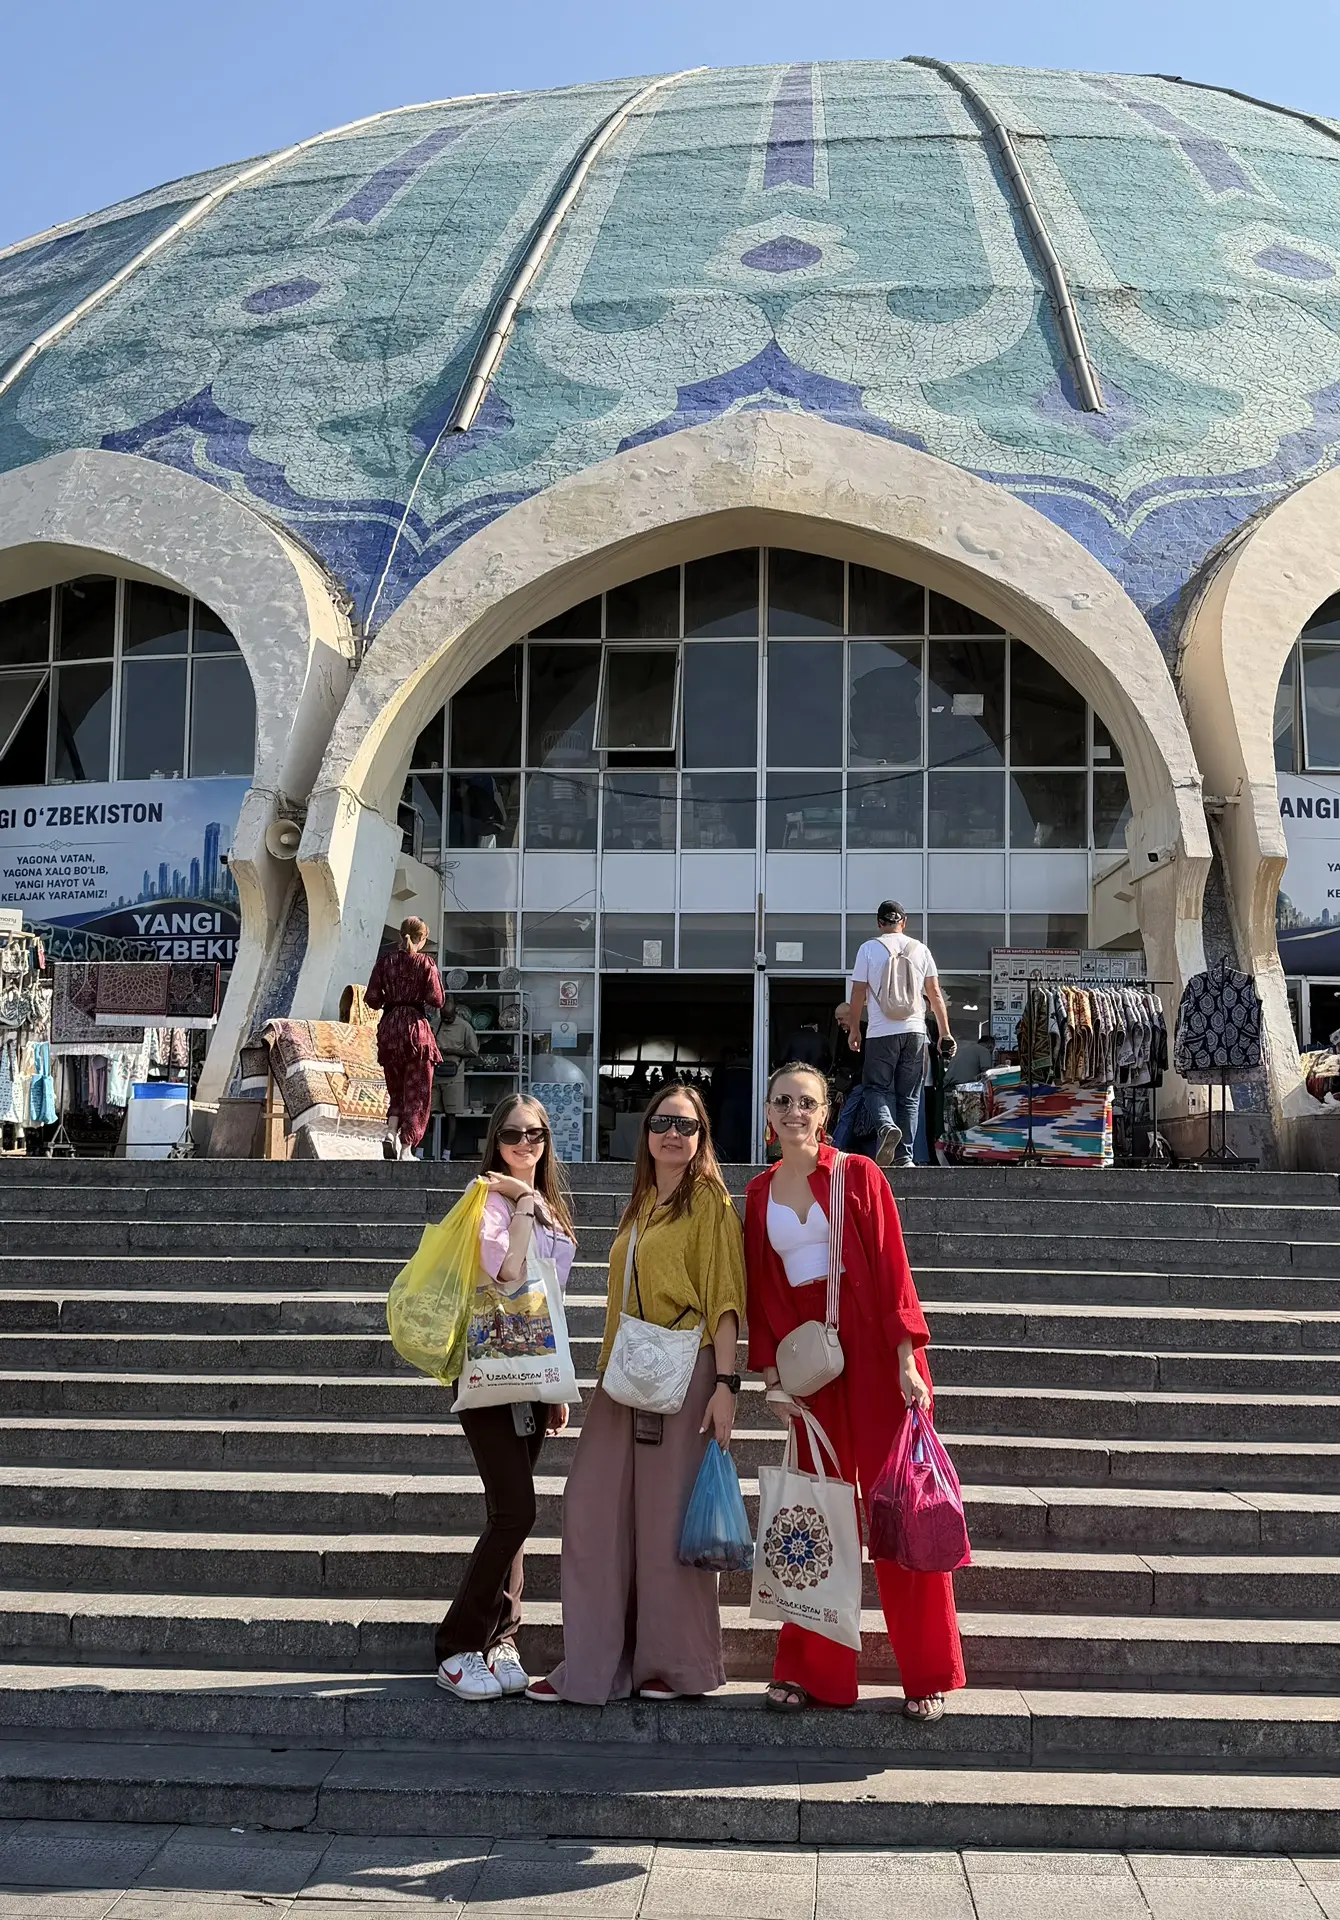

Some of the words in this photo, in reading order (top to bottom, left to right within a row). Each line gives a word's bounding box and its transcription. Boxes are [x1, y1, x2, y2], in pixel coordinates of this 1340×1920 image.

[23, 803, 163, 828] O‘ZBEKISTON
[16, 855, 58, 865] YAGONA
[60, 853, 96, 864] VATAN,
[3, 867, 42, 878] YAGONA
[45, 866, 71, 876] XALQ
[15, 880, 44, 890] YANGI
[46, 878, 79, 888] HAYOT
[82, 878, 96, 887] VA
[1, 891, 46, 902] KELAJAK
[48, 889, 108, 900] YARATAMIZ!
[132, 912, 221, 935] YANGI
